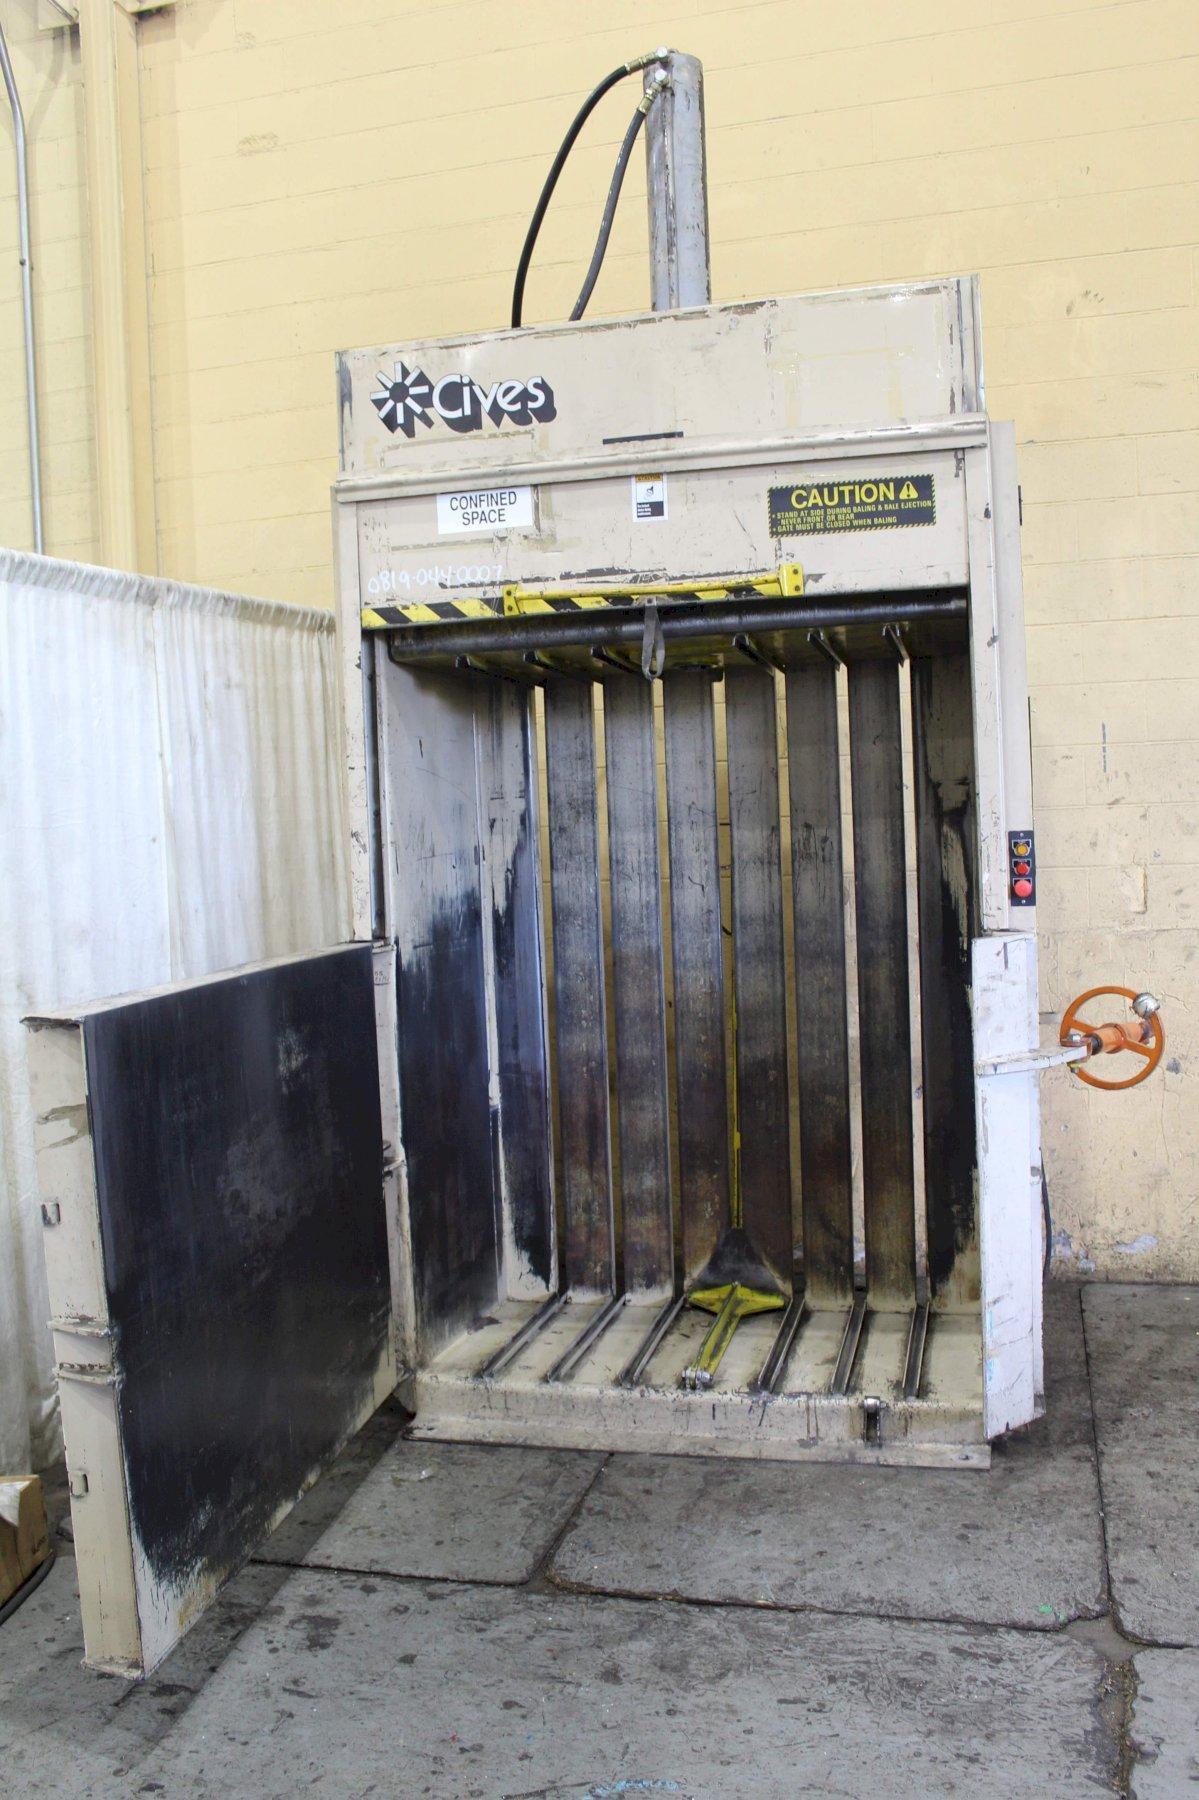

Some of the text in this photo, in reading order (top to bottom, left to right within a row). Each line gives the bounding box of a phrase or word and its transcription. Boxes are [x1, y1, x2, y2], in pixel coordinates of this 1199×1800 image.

[432, 373, 552, 426] Cives
[449, 491, 517, 511] CONFINED
[791, 482, 895, 509] CAUTION
[462, 508, 506, 526] SPACE
[777, 511, 798, 519] STAND
[827, 506, 851, 515] DURING
[853, 504, 876, 513] BALING
[901, 500, 932, 509] EJECTION
[781, 517, 801, 525] NEVER
[838, 513, 855, 521] REAR
[777, 524, 793, 532] GATE
[796, 523, 814, 531] MUST
[826, 519, 850, 528] CLOSED
[853, 518, 871, 526] WHEN
[874, 516, 897, 524] BALING
